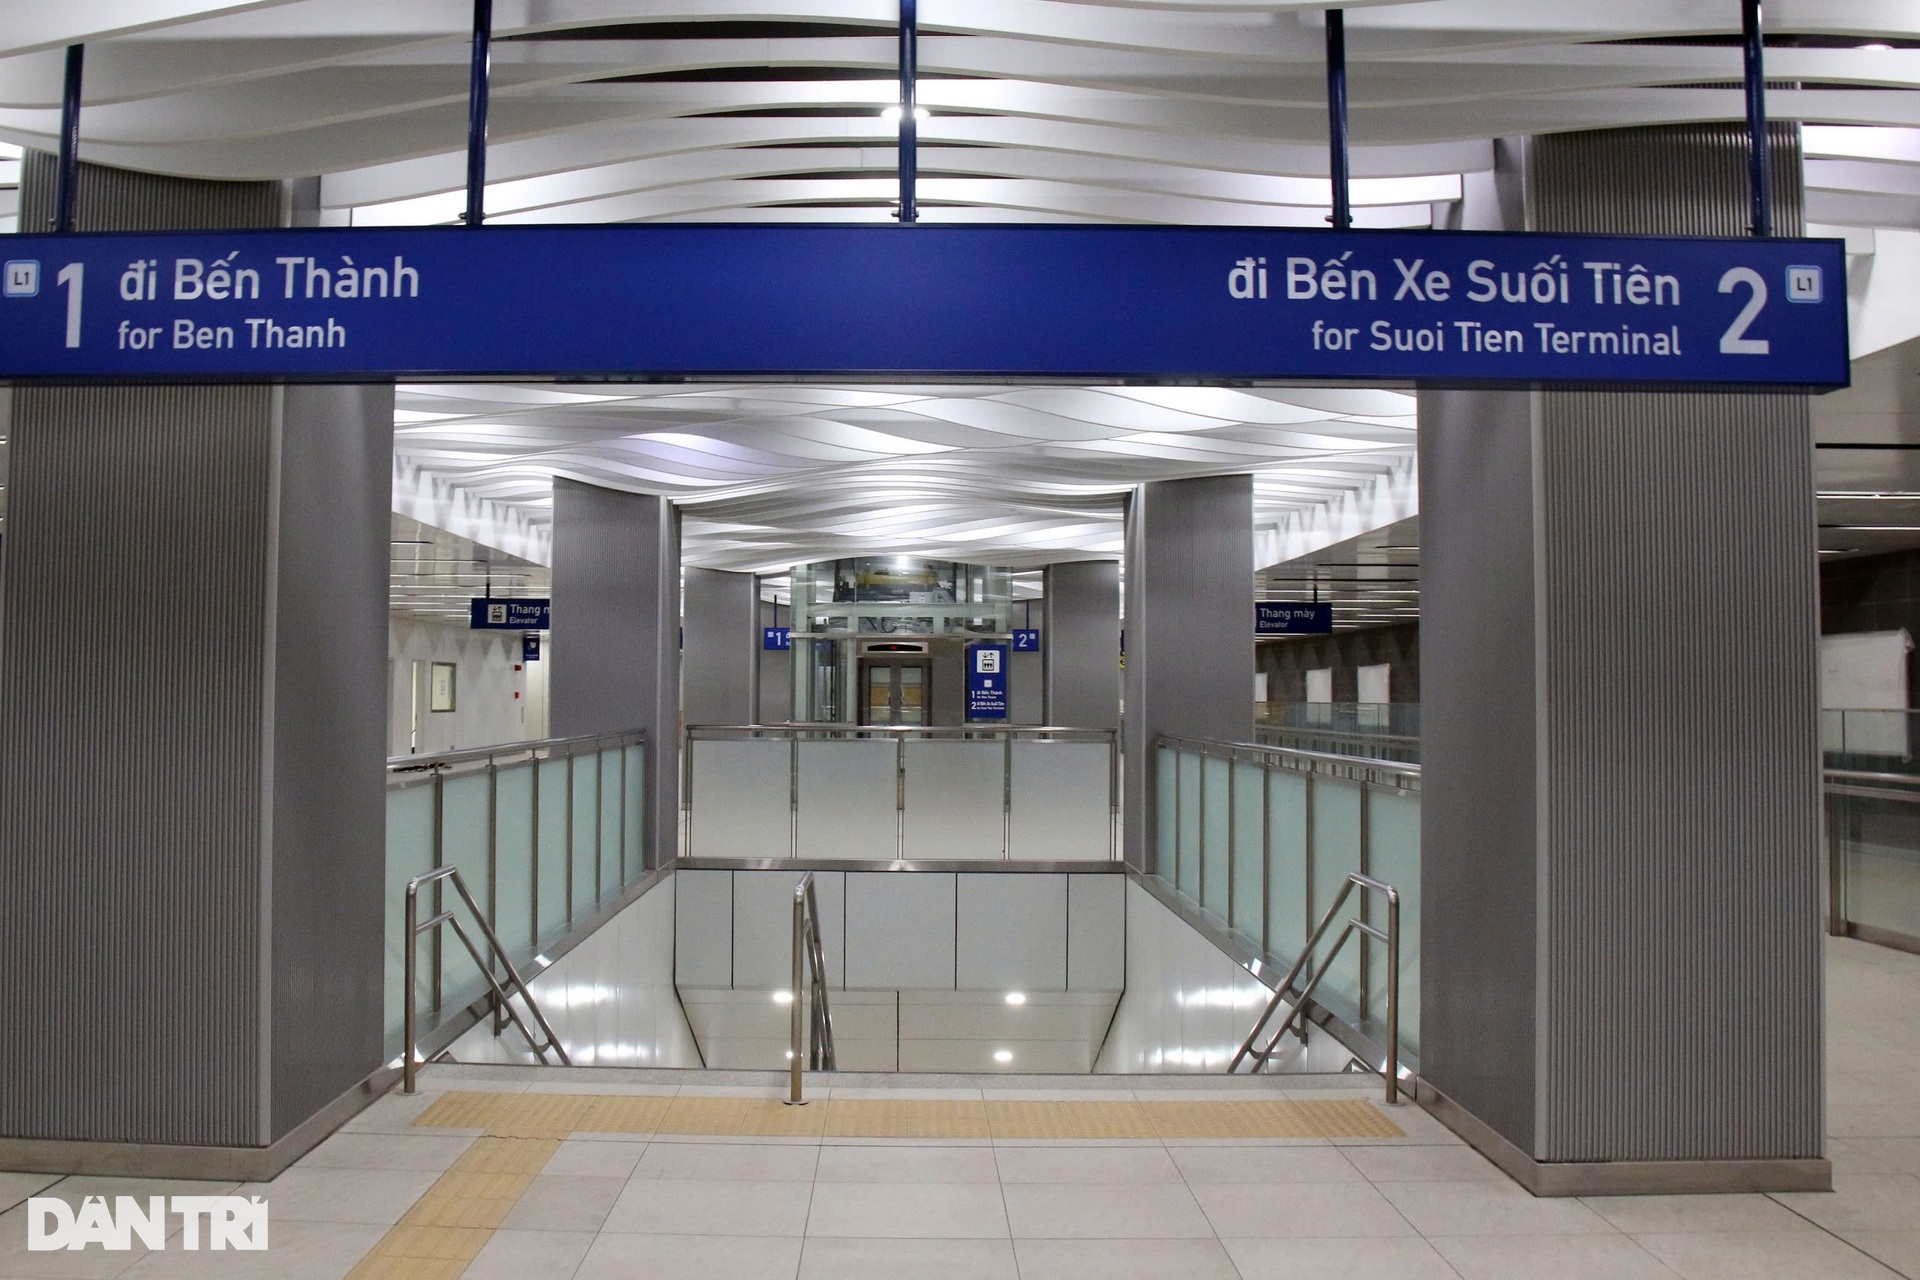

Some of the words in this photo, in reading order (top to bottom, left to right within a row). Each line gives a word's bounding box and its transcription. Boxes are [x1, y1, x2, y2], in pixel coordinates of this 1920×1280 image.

[14, 271, 30, 286] L1
[119, 259, 157, 301] đi
[174, 251, 260, 301] Bến
[276, 255, 420, 299] Thành
[1228, 257, 1268, 299] đi
[1286, 251, 1377, 301] Bến
[1393, 258, 1451, 302] Xe
[1466, 254, 1569, 304] Suối
[1583, 262, 1681, 306] Tiên
[1796, 277, 1813, 292] L1
[56, 262, 84, 349] 1
[1718, 266, 1770, 355] 2
[118, 320, 163, 350] for
[172, 319, 234, 349] Ben
[244, 318, 346, 348] Thanh
[1312, 320, 1360, 350] for
[1370, 320, 1444, 351] Suoi
[1453, 321, 1524, 353] Tien
[1533, 323, 1682, 356] Terminal
[509, 604, 541, 616] Thang
[1260, 608, 1291, 620] Thang
[1293, 608, 1316, 620] máy
[1259, 621, 1289, 629] Elevator
[775, 631, 782, 646] 1
[1018, 633, 1028, 648] 2
[971, 690, 976, 699] 1
[971, 701, 977, 710] 2
